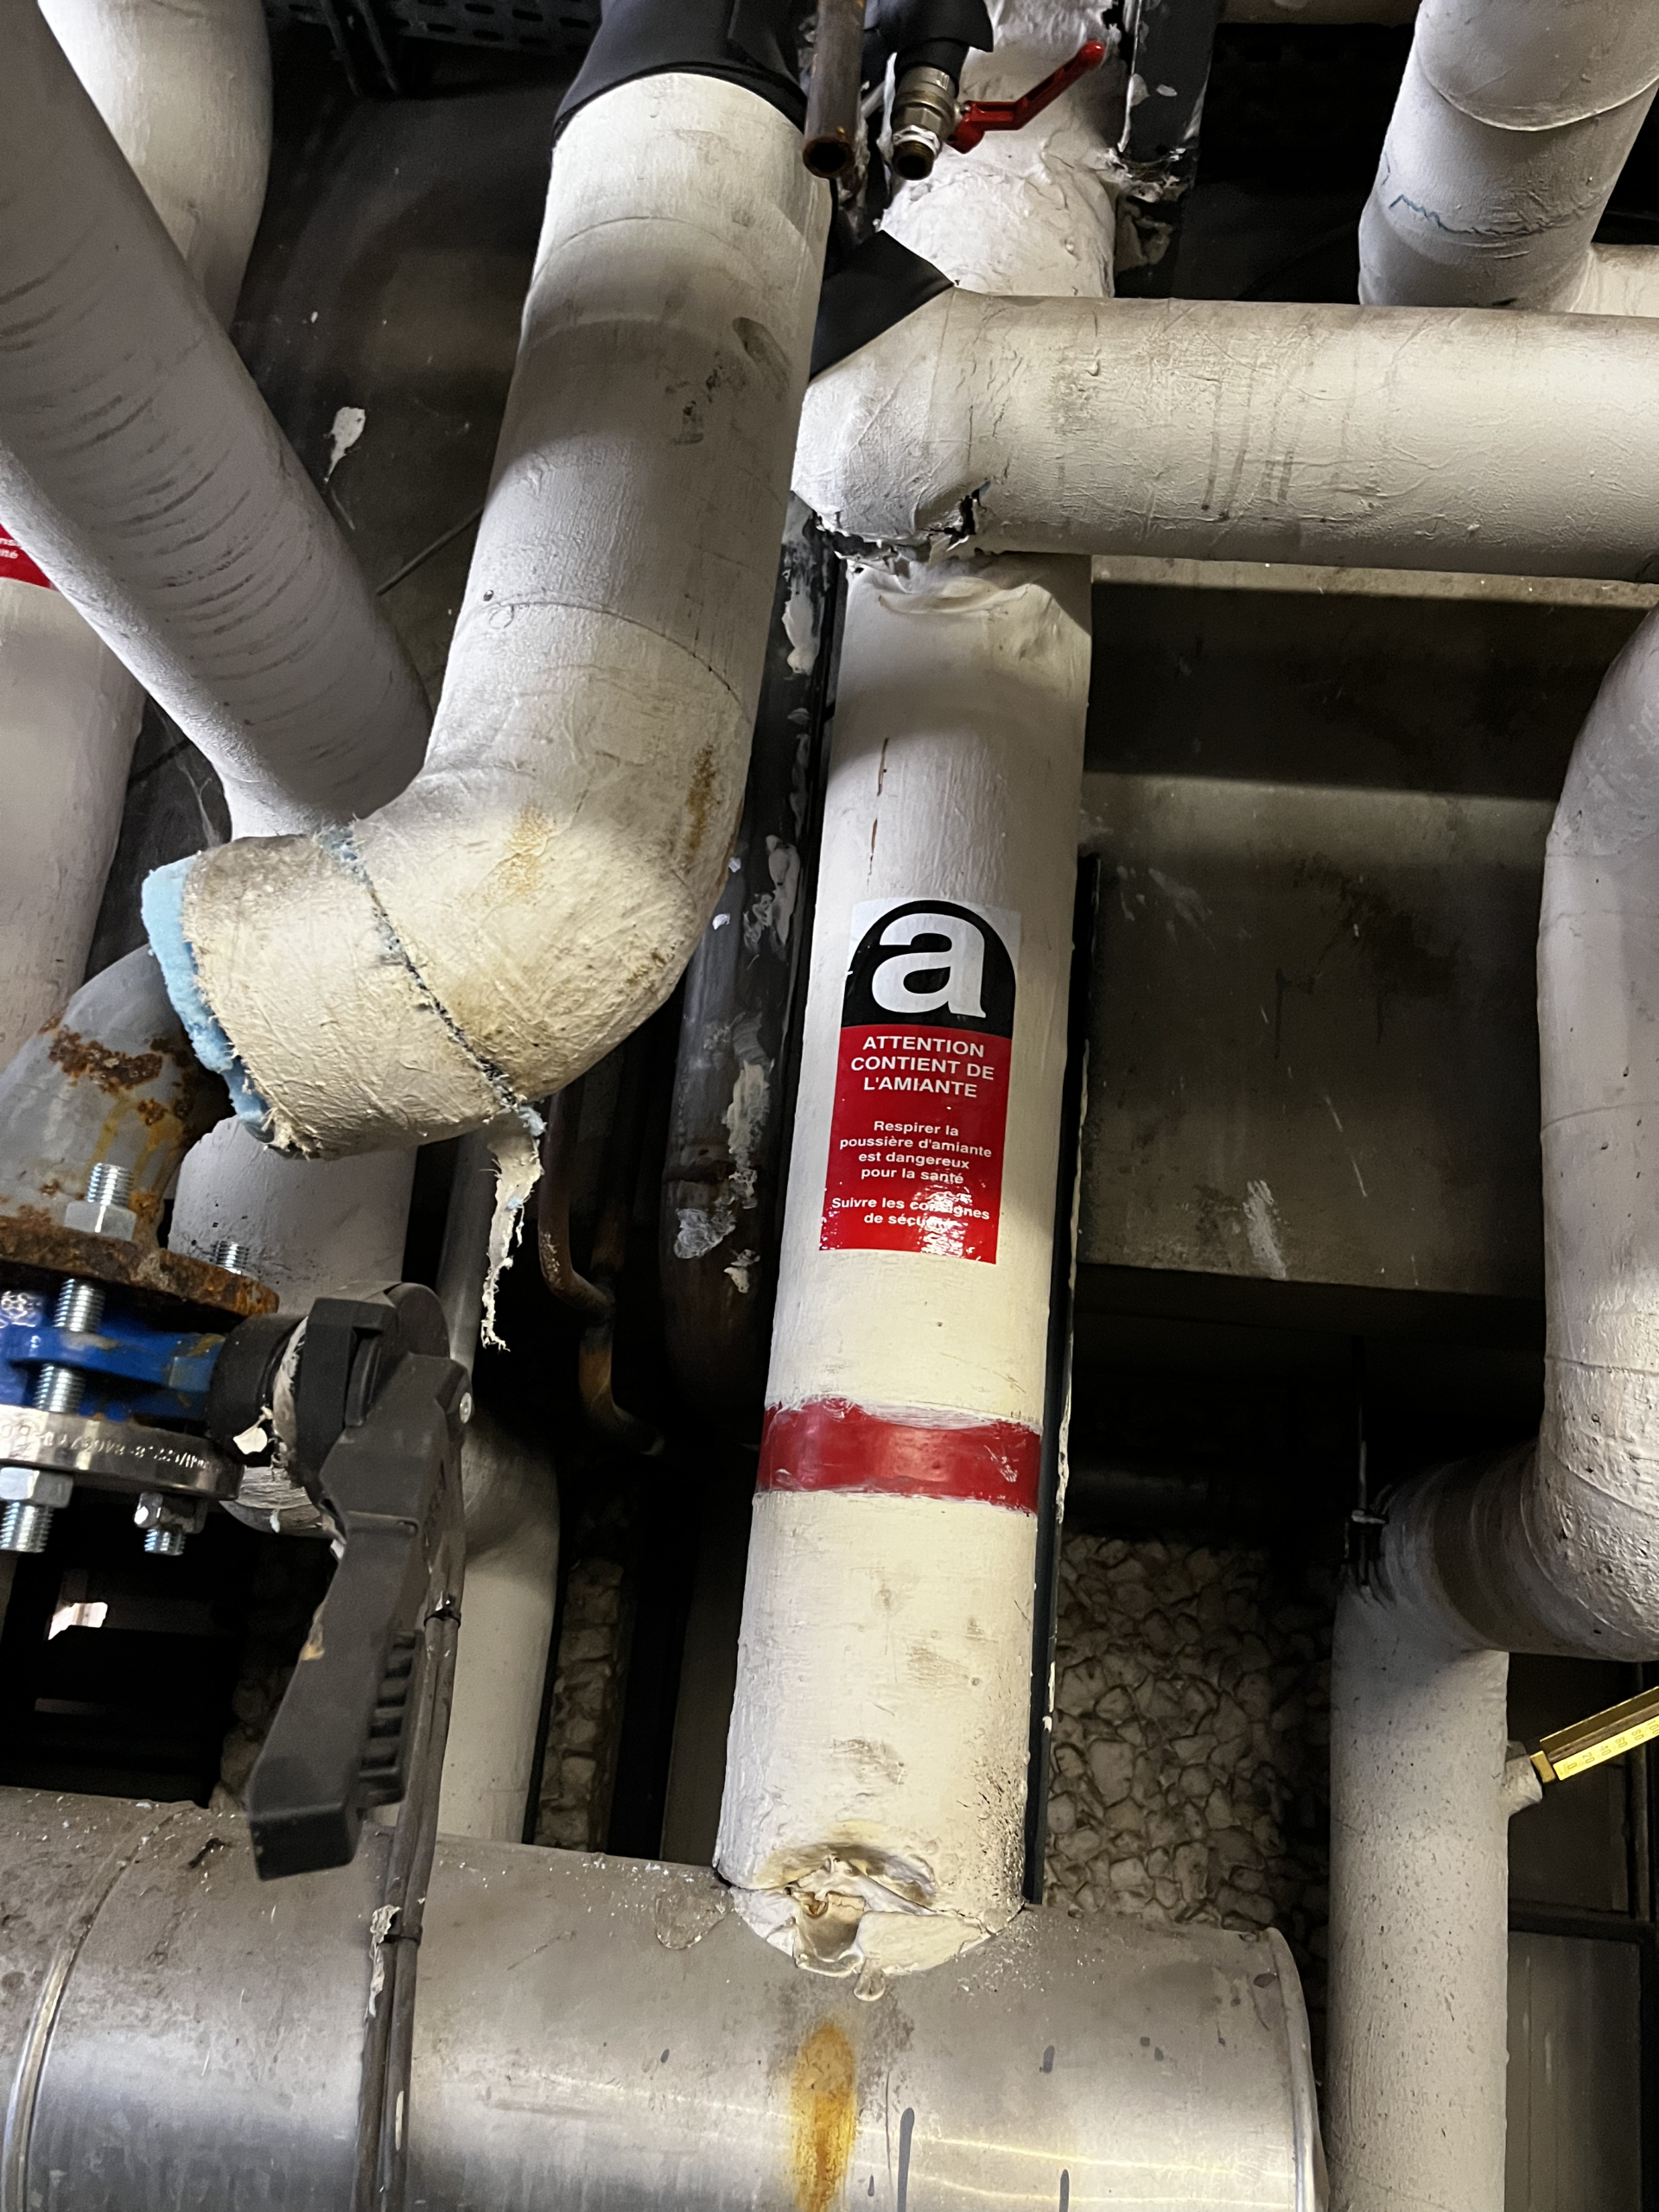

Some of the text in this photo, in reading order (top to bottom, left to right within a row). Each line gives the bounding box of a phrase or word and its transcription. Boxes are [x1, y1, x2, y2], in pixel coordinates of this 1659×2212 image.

[872, 912, 986, 1018] a
[862, 1035, 984, 1058] ATTENTION
[850, 1056, 995, 1080] CONTIENT DE
[863, 1077, 977, 1098] L'AMIANTE
[874, 1121, 959, 1136] Respirer la
[839, 1135, 992, 1158] poussière d'amiante
[858, 1151, 969, 1170] est dangereux
[861, 1167, 964, 1185] pour la santé
[831, 1197, 990, 1220] Suivre les congnes
[863, 1213, 883, 1224] de
[1599, 1745, 1611, 1756] 40
[1615, 1737, 1628, 1748] 60
[1582, 1751, 1595, 1764] 20
